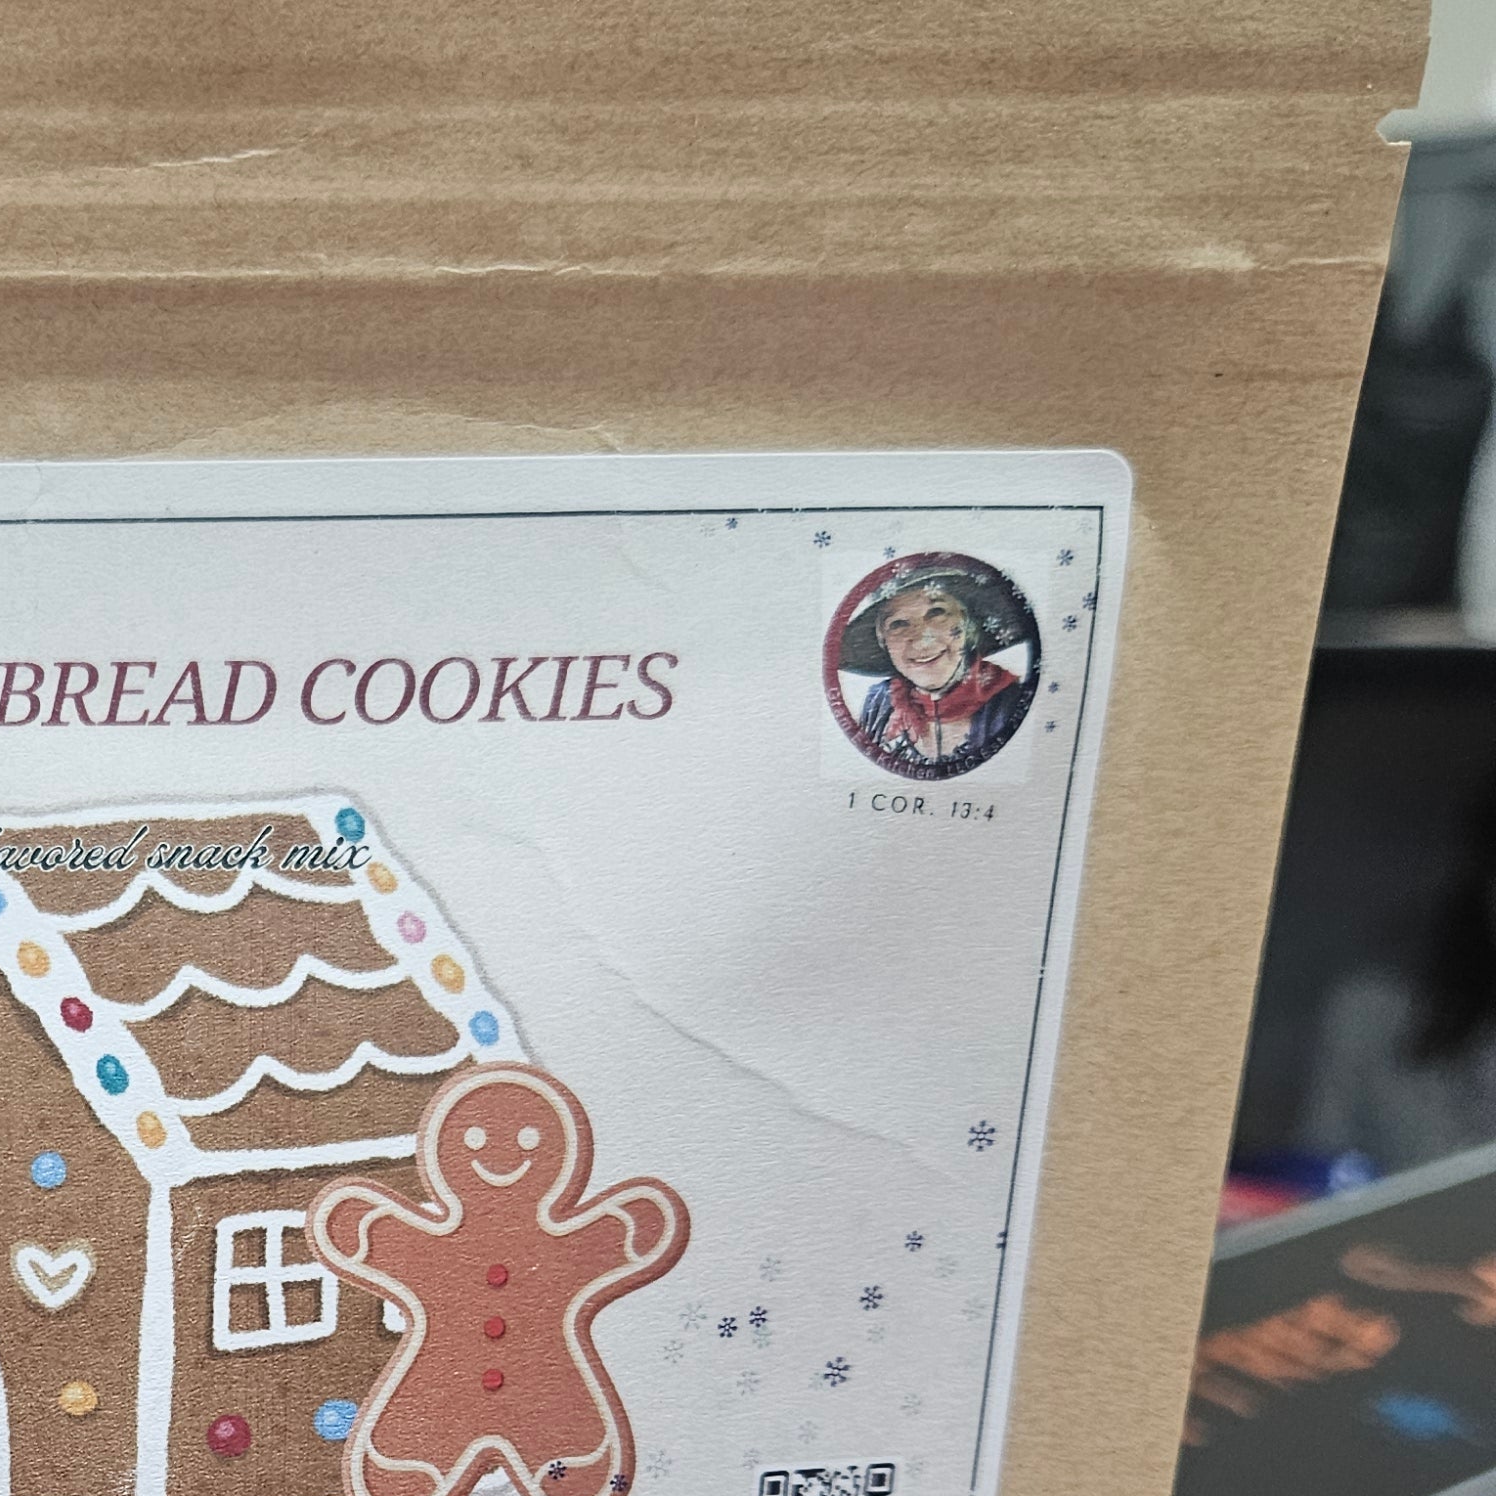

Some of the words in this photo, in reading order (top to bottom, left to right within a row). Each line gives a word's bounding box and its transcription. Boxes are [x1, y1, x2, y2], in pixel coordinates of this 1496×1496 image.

[301, 651, 679, 725] COOKIES
[848, 792, 856, 809] 1
[871, 793, 934, 816] COR.
[950, 801, 994, 822] 13:4
[147, 825, 272, 869] snack
[281, 836, 372, 870] mix
